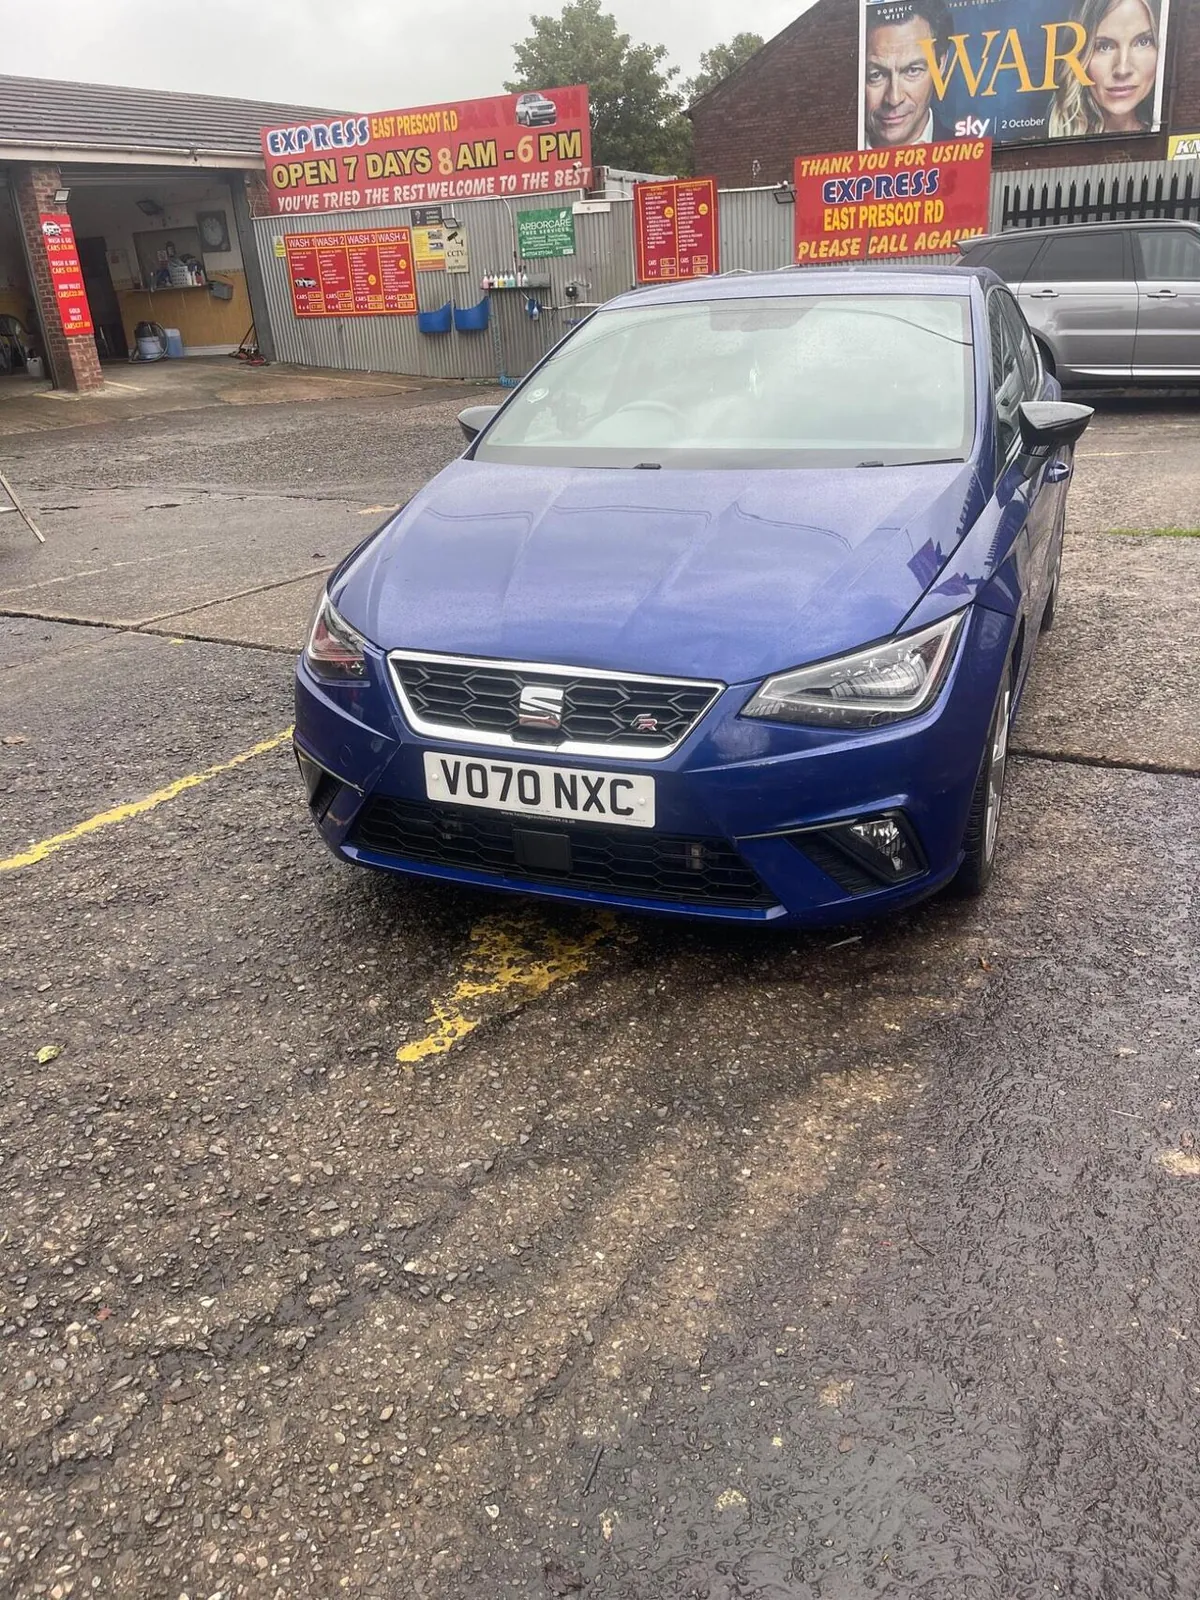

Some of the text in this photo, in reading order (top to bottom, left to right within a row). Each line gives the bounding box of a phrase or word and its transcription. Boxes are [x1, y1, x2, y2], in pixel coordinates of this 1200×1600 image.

[877, 5, 913, 15] DOMINIC
[916, 22, 1096, 101] WAR
[267, 117, 370, 156] EXPRESS
[372, 118, 396, 139] EAST
[397, 115, 443, 137] PRESCOT
[443, 111, 459, 133] RD
[955, 116, 990, 138] sky
[1001, 117, 1045, 130] 2 October
[272, 159, 339, 190] OPEN
[342, 156, 359, 181] 7
[365, 147, 433, 180] DAYS
[437, 148, 454, 175] 8
[455, 139, 498, 170] AM
[517, 135, 533, 163] 6
[538, 129, 582, 162] PM
[801, 142, 984, 177] THANK YOU FOR USING
[277, 167, 591, 212] YOU'VE TRIED THE REST WELCOME TO THE BEST
[823, 168, 940, 204] EXPRESS
[520, 218, 571, 230] ARBORCARE
[824, 199, 944, 231] EAST PRESCOT RD
[288, 238, 309, 248] WASH
[317, 236, 345, 247] WASH 2
[347, 234, 376, 244] WASH 3
[378, 232, 407, 242] WASH 4
[798, 237, 861, 259] PLEASE
[869, 232, 909, 254] CALL
[554, 772, 634, 816] NXC
